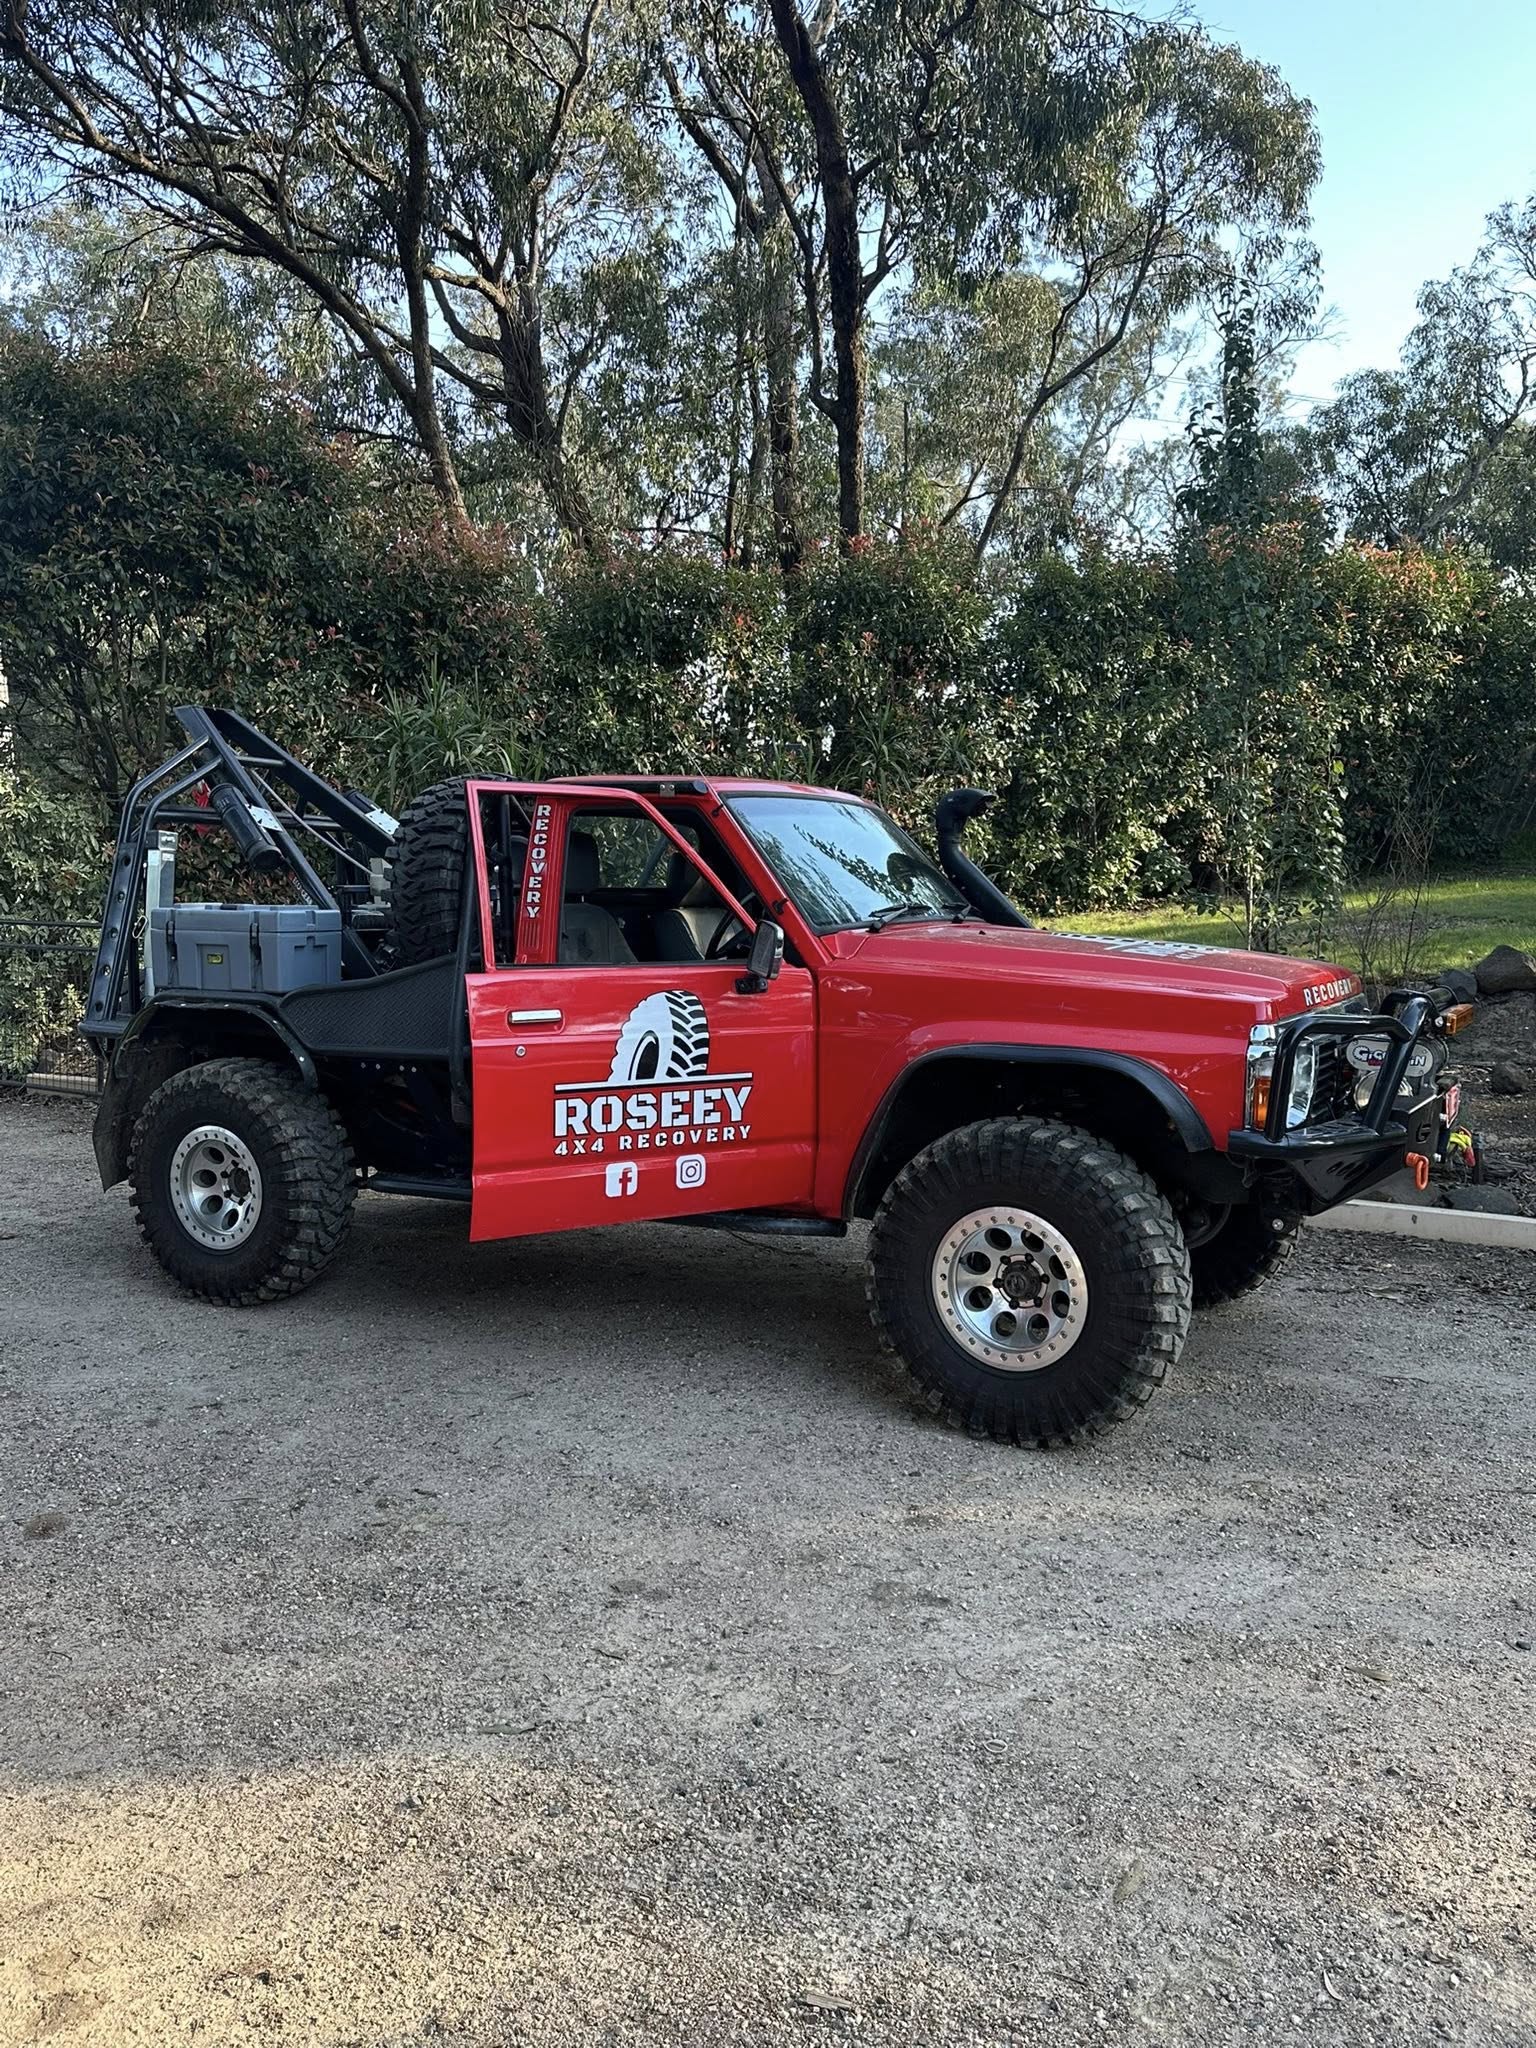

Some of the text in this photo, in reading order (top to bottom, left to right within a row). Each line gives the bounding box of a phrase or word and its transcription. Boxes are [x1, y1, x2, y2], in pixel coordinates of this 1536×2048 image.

[526, 805, 551, 918] RECOVERY
[554, 1086, 752, 1137] ROSEEY
[554, 1125, 751, 1156] 4X4 RECOVERY
